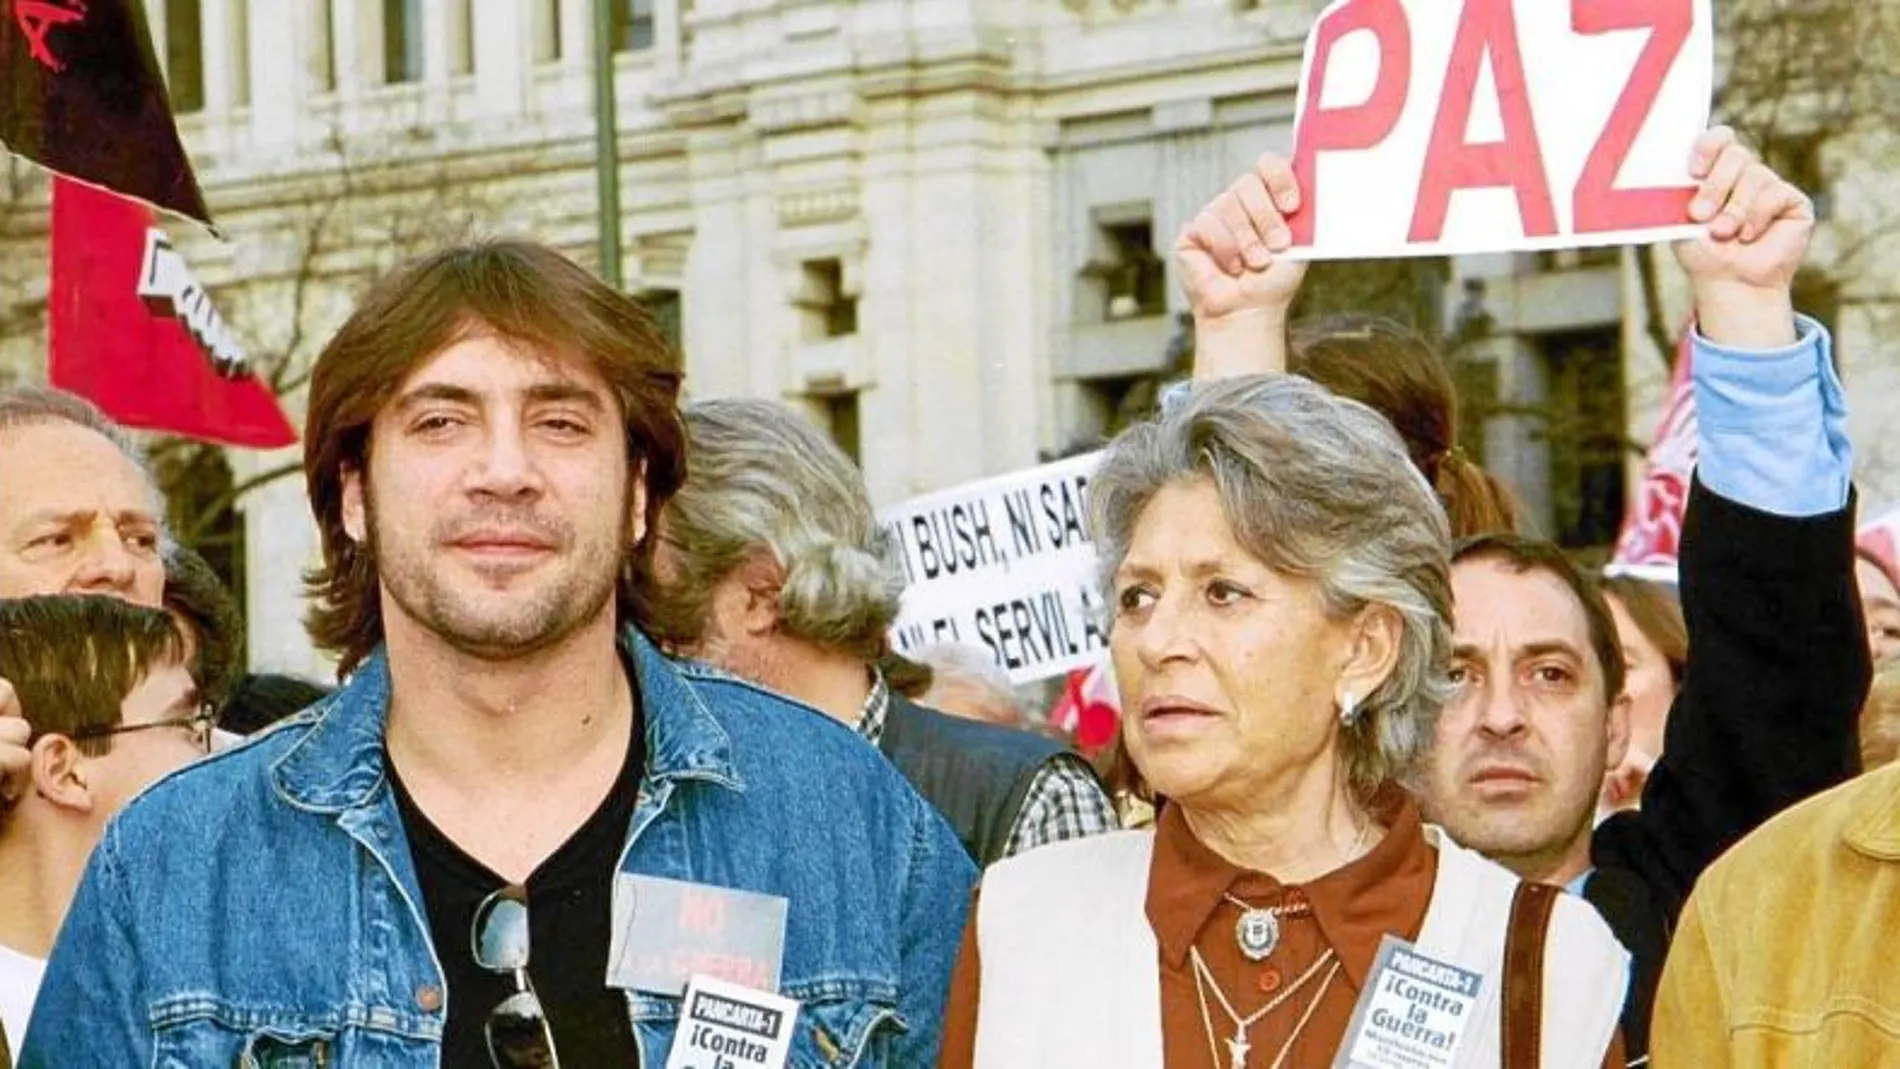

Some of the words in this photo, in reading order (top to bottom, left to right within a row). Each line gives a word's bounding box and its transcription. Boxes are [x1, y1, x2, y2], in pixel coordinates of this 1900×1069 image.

[1291, 0, 1699, 246] PAZ
[912, 499, 1010, 580] BUSH,
[1003, 488, 1041, 557] NI
[975, 590, 1079, 670] SERVIL
[1371, 1008, 1457, 1052] Guerra!
[1407, 1003, 1428, 1024] la
